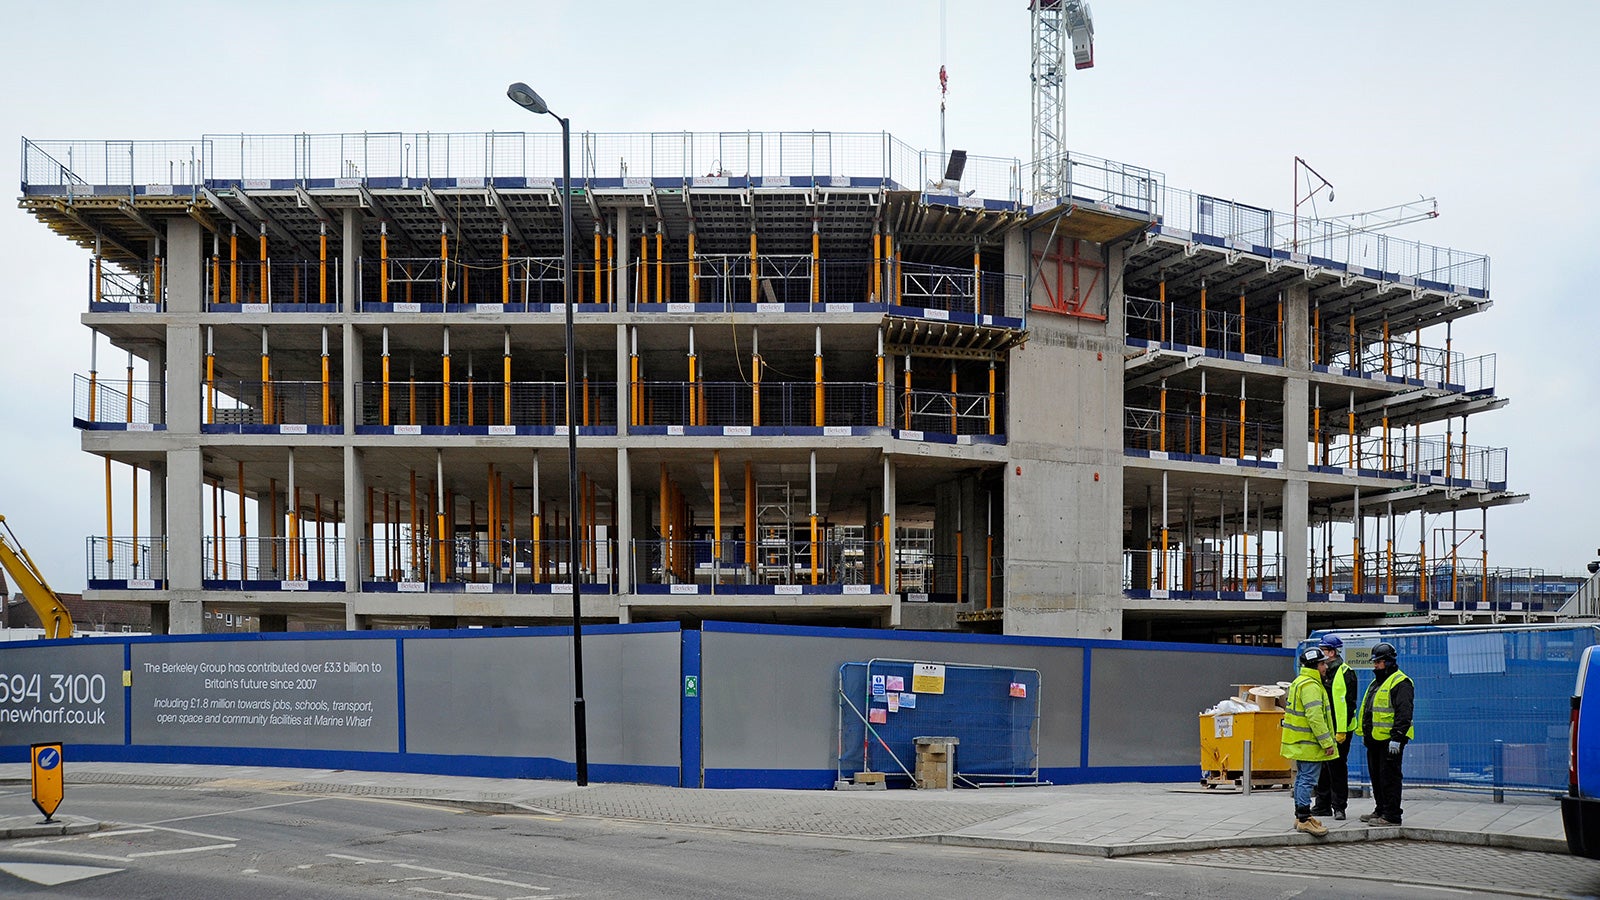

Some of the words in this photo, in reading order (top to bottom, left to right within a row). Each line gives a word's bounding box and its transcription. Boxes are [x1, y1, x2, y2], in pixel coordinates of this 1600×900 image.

[144, 663, 160, 673] The
[162, 662, 198, 675] Berkeley
[200, 663, 226, 675] Group
[228, 662, 245, 673] has
[247, 662, 299, 673] contributed
[301, 664, 322, 673] over
[343, 661, 369, 673] billion
[371, 662, 382, 673] to
[49, 674, 106, 704] 3100
[204, 678, 239, 689] Britain's
[240, 678, 268, 689] future
[269, 678, 295, 690] since
[296, 679, 317, 690] 2007
[154, 697, 189, 711] Including
[190, 697, 209, 709] £1.8
[210, 698, 236, 709] million
[237, 699, 272, 710] towards
[271, 699, 293, 712] jobs,
[295, 700, 330, 712] schools,
[332, 701, 374, 714] transport,
[157, 714, 178, 724] open
[178, 714, 204, 725] space
[204, 713, 221, 724] and
[222, 714, 268, 727] community
[269, 713, 302, 726] facilities
[303, 715, 312, 726] at
[313, 715, 344, 726] Marine
[345, 716, 373, 727] Wharf
